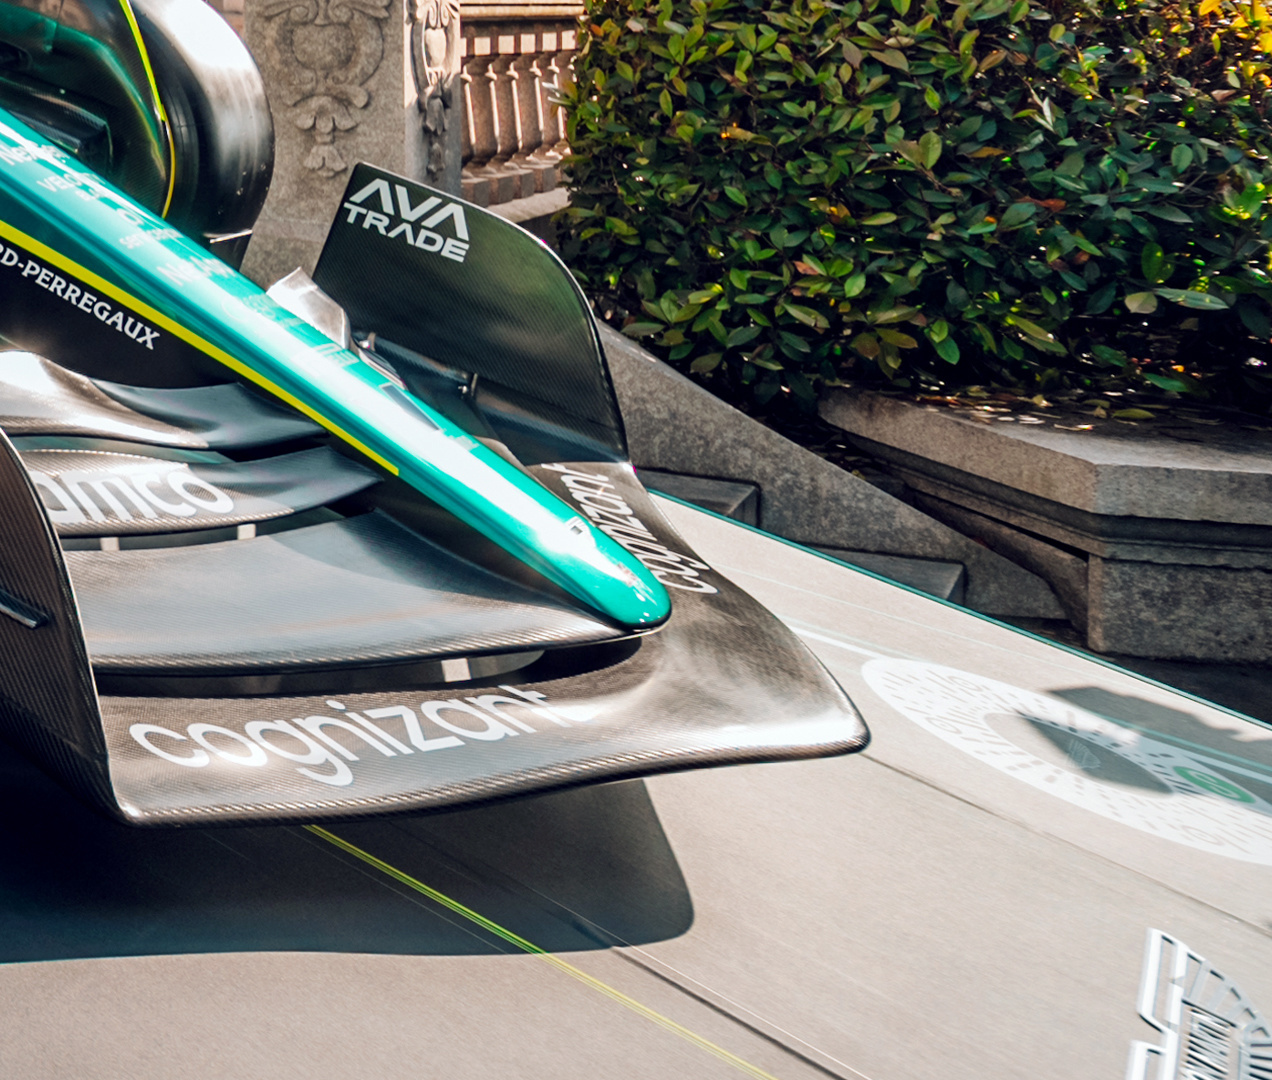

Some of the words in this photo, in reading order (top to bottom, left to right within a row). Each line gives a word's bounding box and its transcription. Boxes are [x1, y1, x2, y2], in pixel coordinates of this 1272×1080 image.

[343, 201, 470, 263] TRADE
[348, 177, 470, 242] AVA
[128, 684, 573, 787] cognizant
